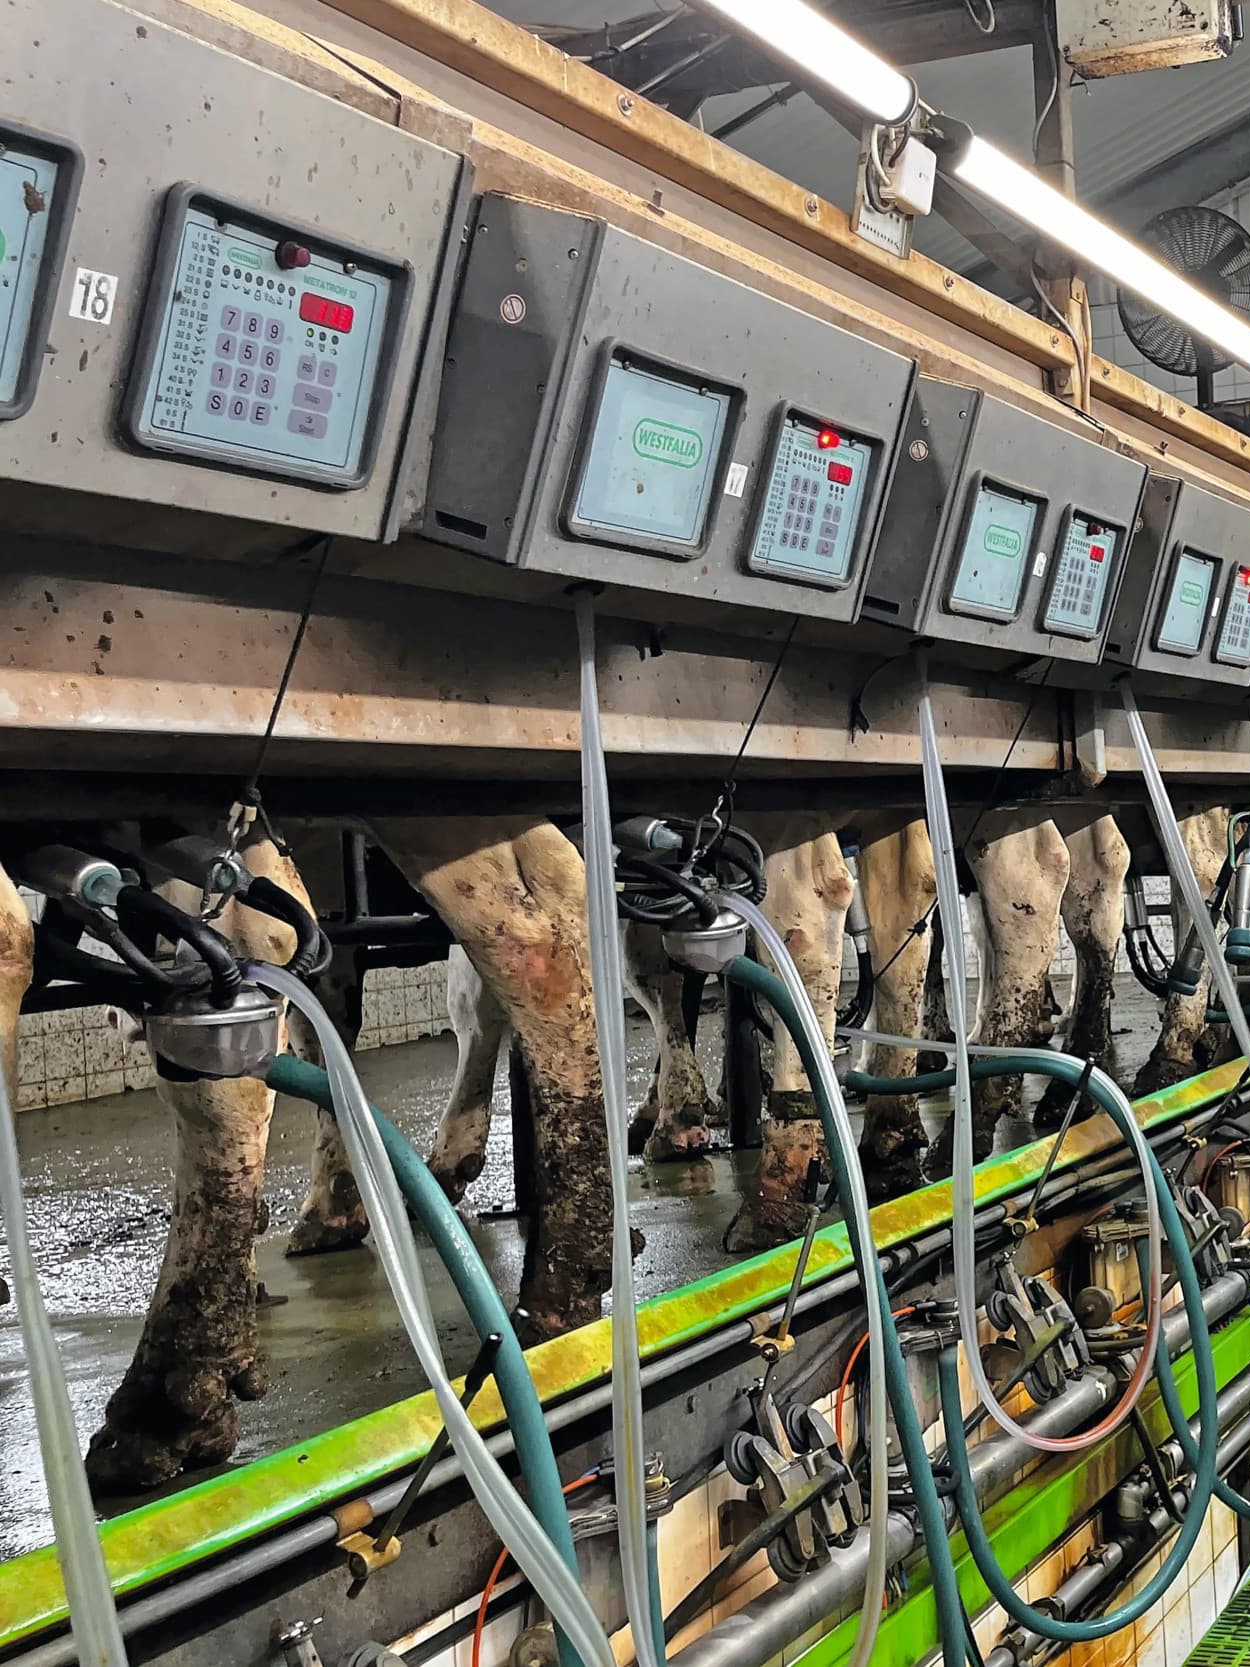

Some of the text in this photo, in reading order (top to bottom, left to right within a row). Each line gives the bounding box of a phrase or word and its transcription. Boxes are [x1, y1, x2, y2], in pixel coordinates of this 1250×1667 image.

[79, 273, 110, 320] 18
[228, 311, 279, 339] 7 8 9
[222, 339, 275, 366] 4 5 6
[218, 367, 270, 394] 1 2 3
[302, 362, 313, 373] RS
[324, 369, 330, 378] C
[210, 395, 266, 421] S 0 E
[639, 428, 697, 459] WESTFALIA
